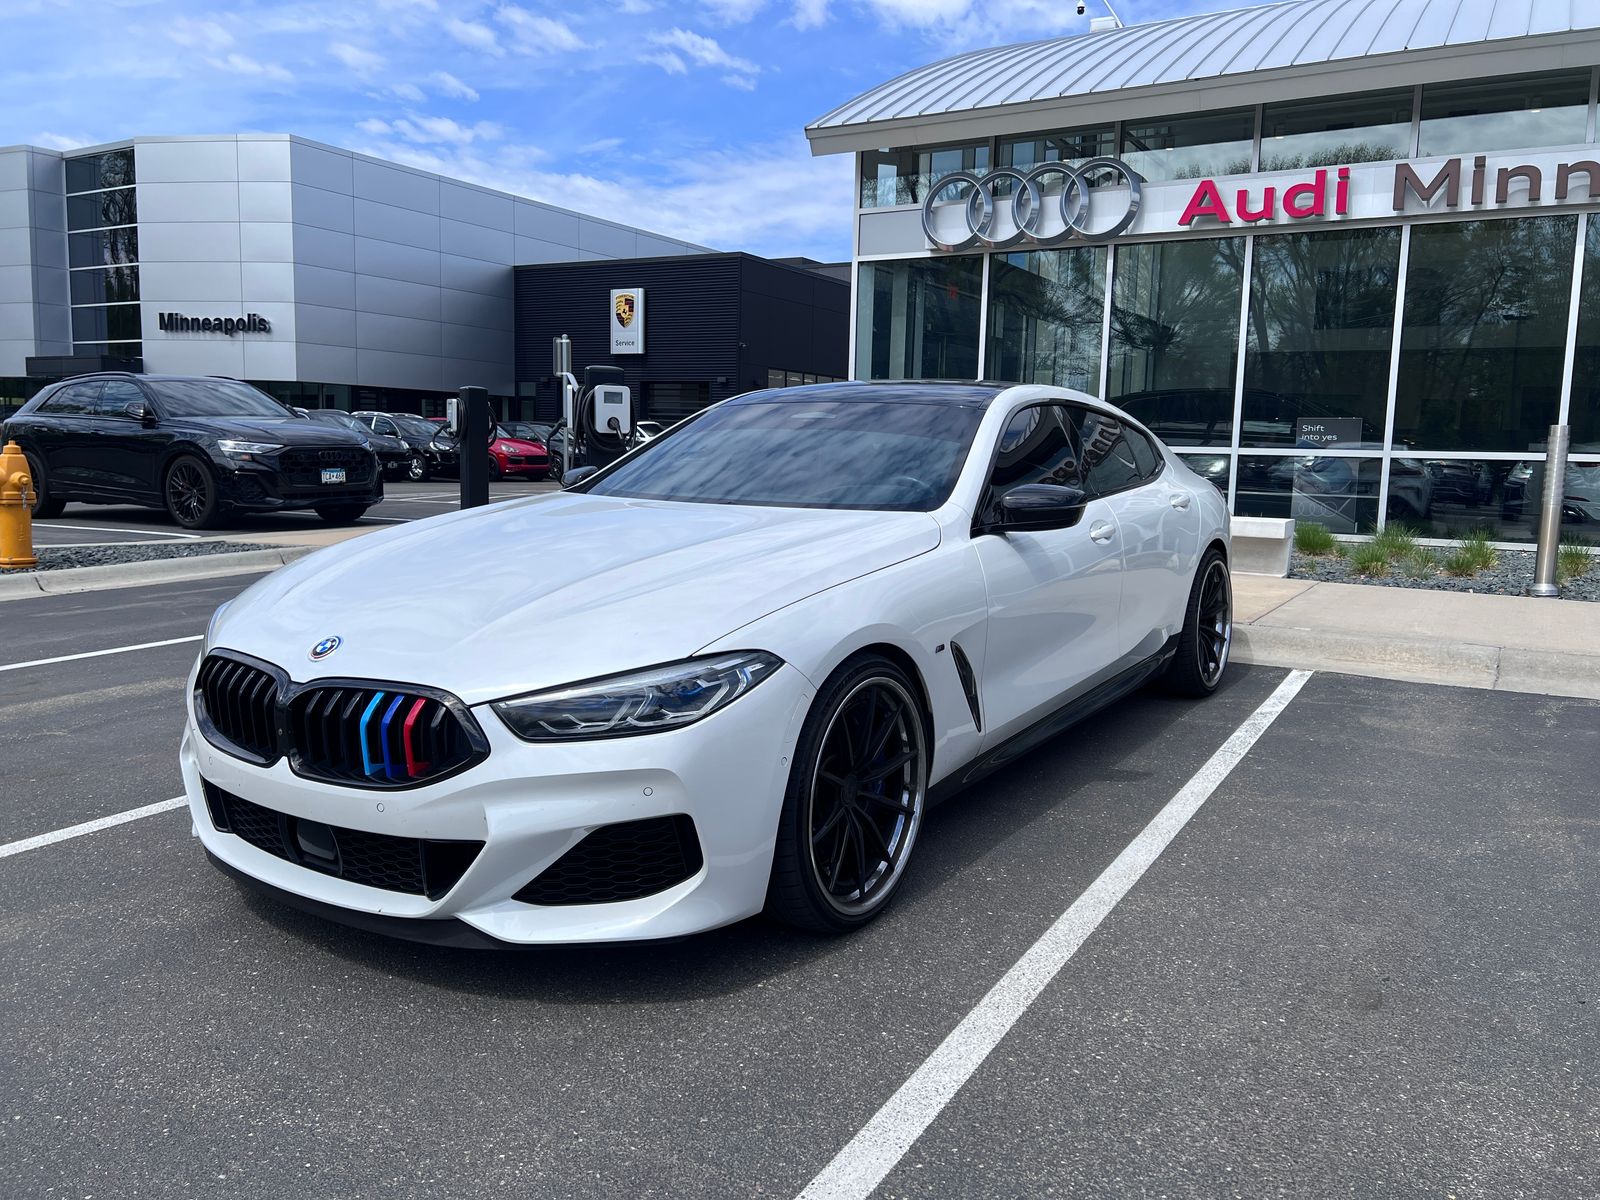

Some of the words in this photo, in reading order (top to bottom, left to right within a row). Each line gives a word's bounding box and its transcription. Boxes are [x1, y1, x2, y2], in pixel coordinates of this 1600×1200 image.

[1178, 166, 1351, 227] Audi
[1392, 155, 1600, 211] Minn
[158, 312, 270, 336] Minneapolis
[615, 339, 635, 347] Service
[1302, 424, 1325, 432] Shift
[1301, 433, 1320, 441] into
[1321, 434, 1338, 442] yes
